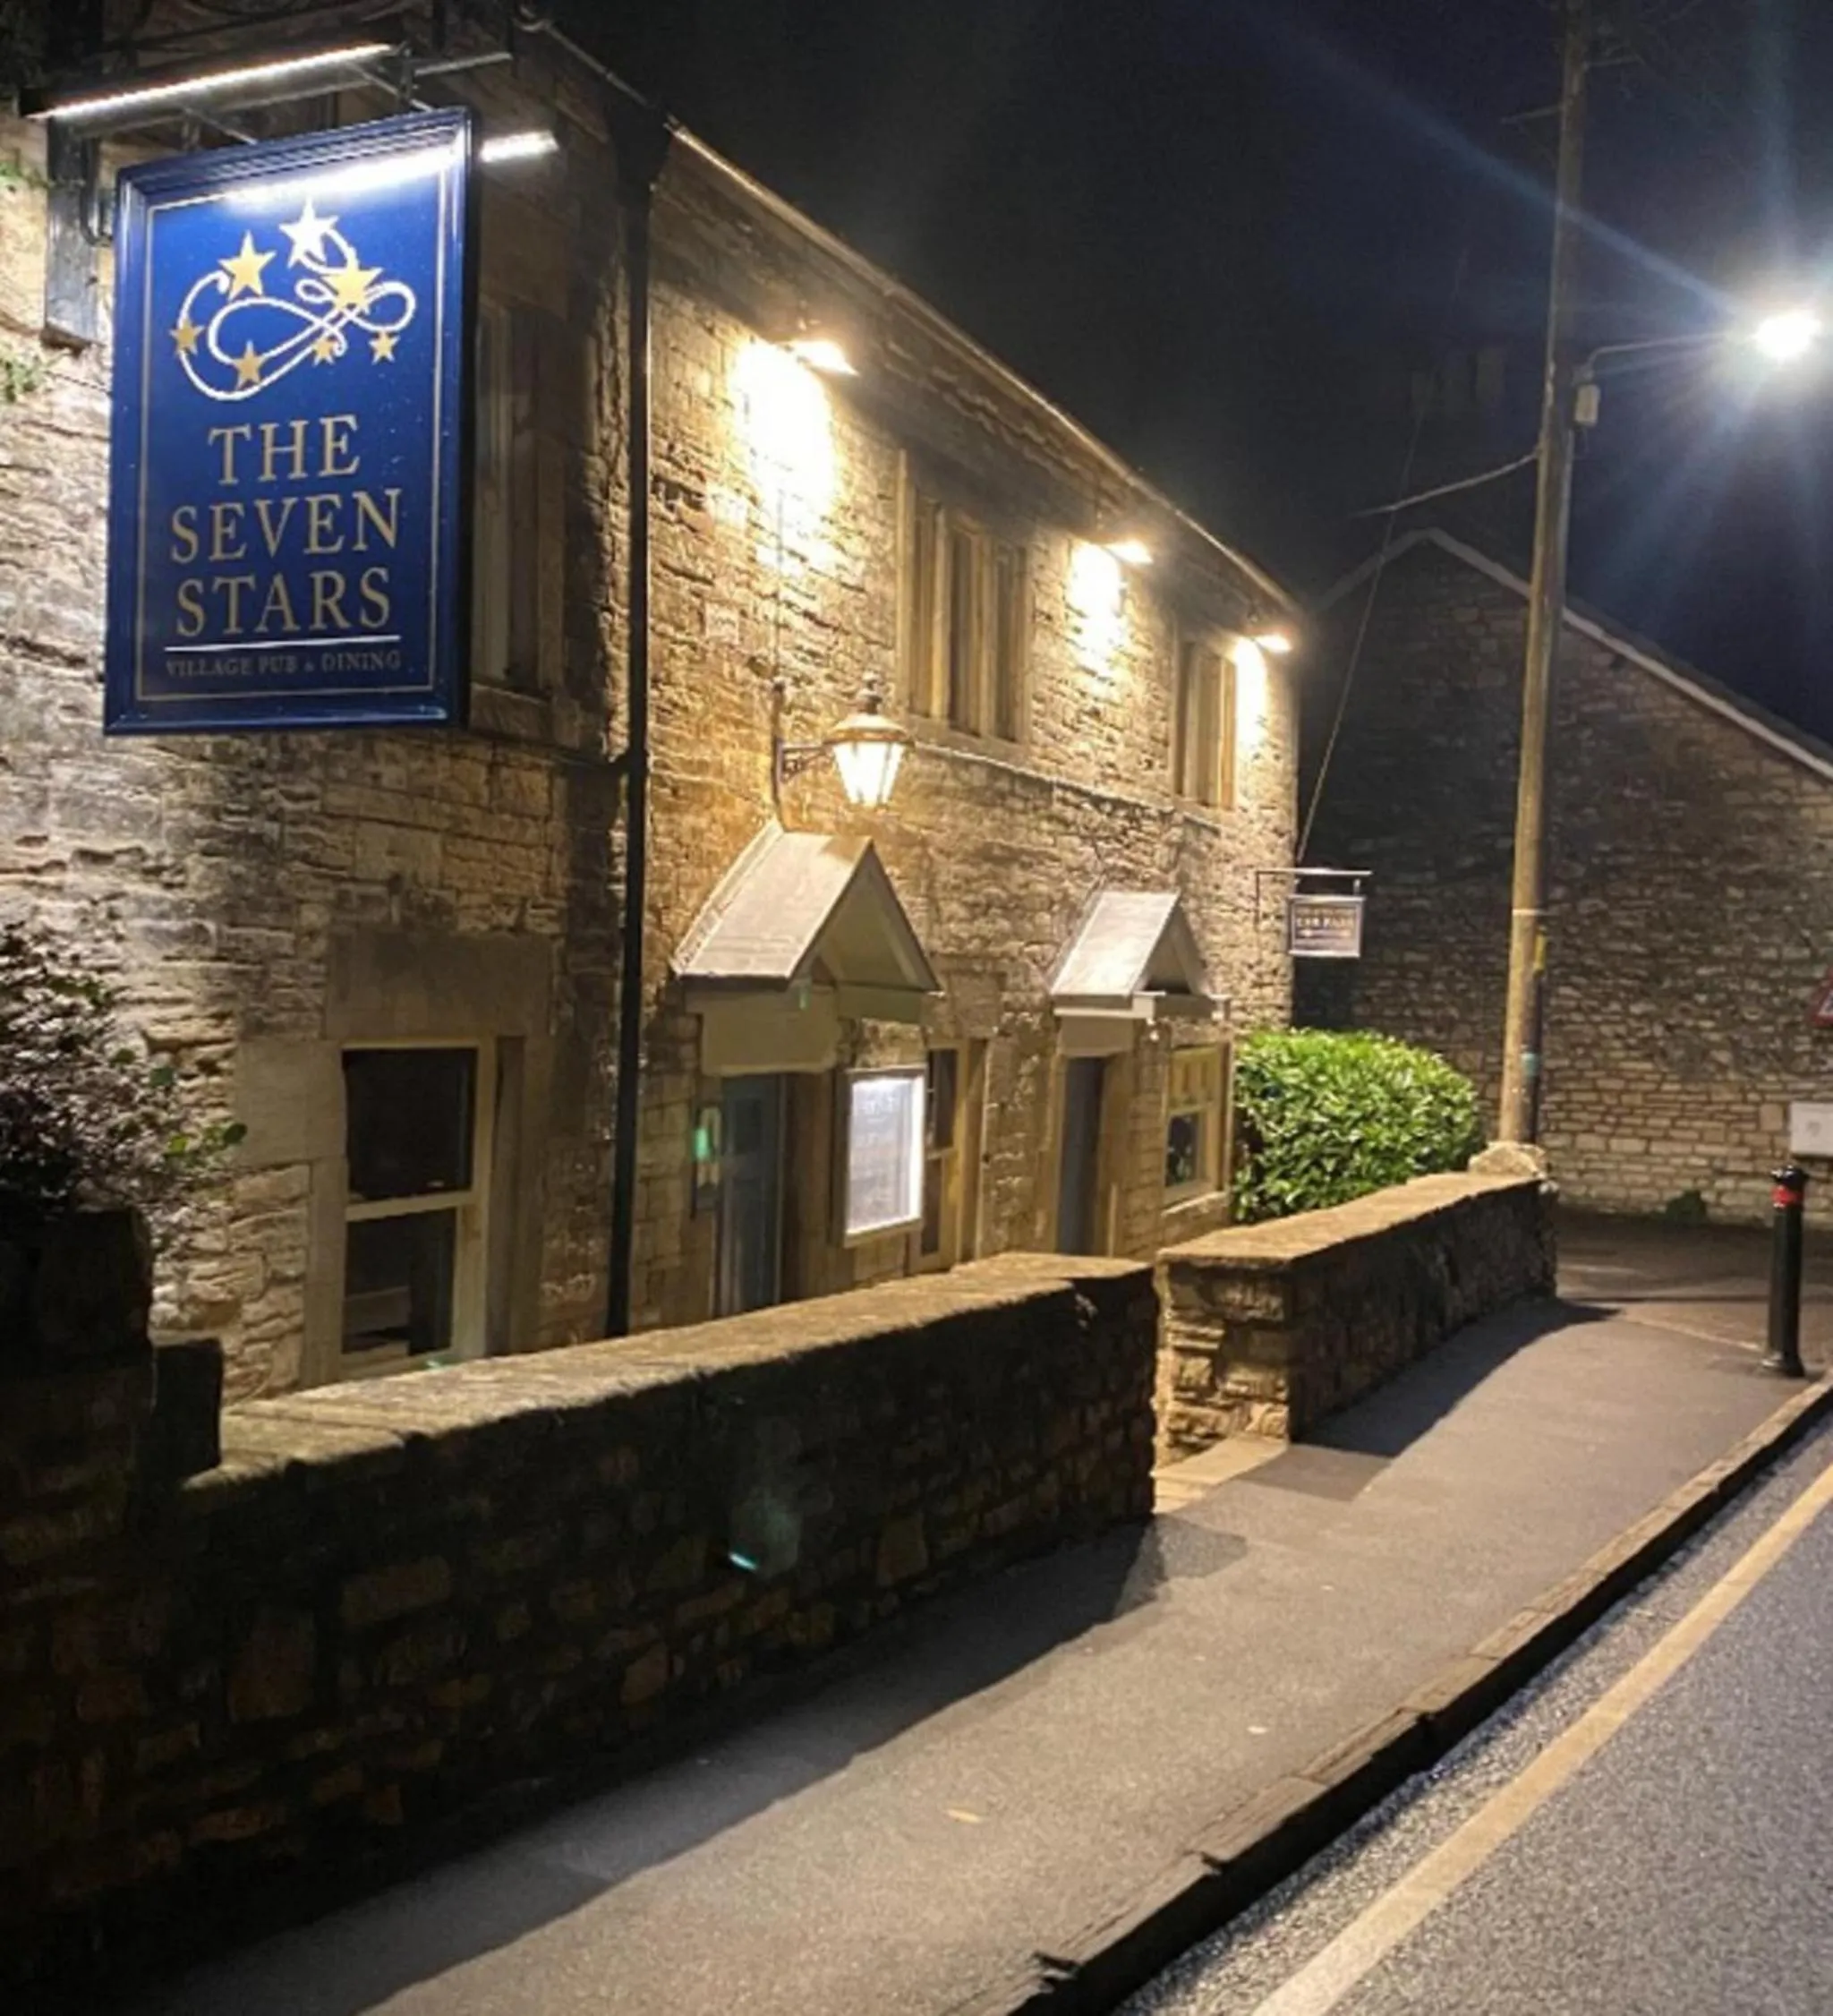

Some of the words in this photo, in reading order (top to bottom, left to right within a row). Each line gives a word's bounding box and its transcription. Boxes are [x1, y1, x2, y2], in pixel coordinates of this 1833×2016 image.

[207, 414, 360, 485] THE
[170, 488, 403, 564] SEVEN
[176, 567, 391, 637] STARS
[166, 657, 255, 678] VILLAGE
[259, 654, 298, 674] PUB
[320, 649, 403, 673] DINING
